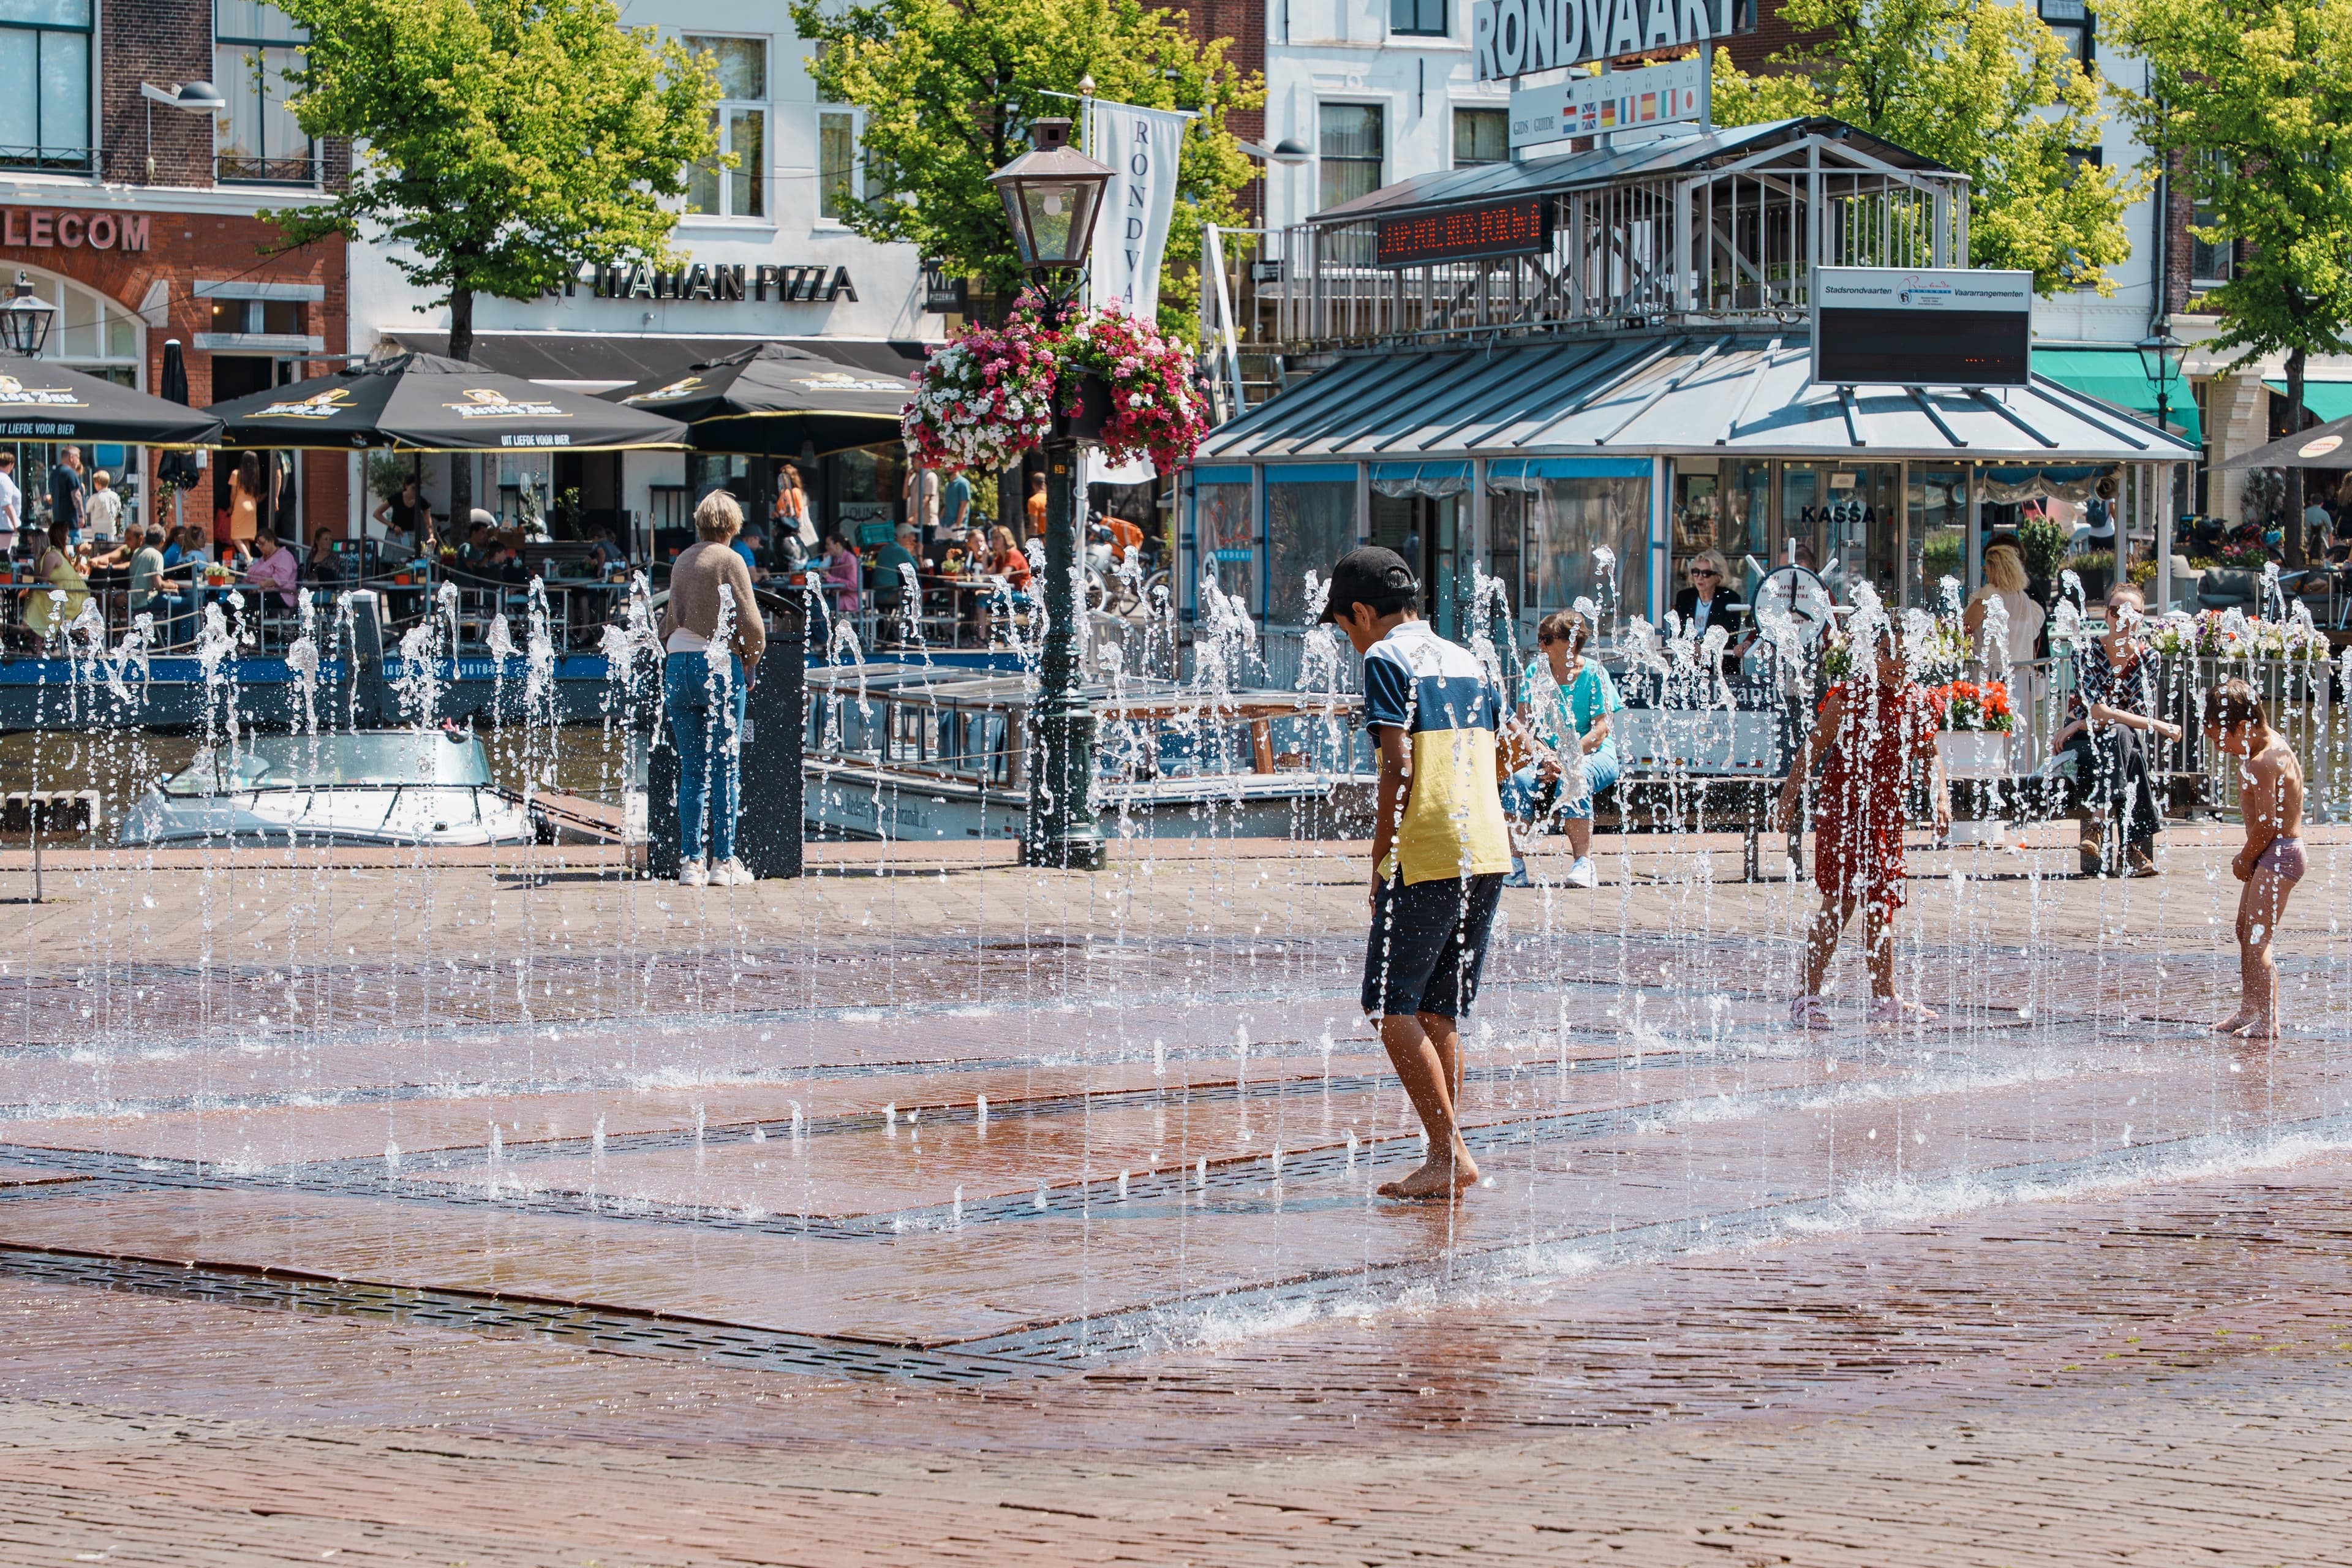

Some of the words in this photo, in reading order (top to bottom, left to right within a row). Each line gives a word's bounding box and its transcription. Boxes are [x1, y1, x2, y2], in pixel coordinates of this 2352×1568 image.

[1513, 120, 1529, 135] GIDS
[1534, 116, 1554, 132] GUIDE
[4, 209, 150, 250] LECOM
[594, 260, 745, 300] ITALIAN
[756, 265, 858, 302] PIZZA
[1825, 285, 1892, 294] Stadsrondvaarten
[1954, 288, 2024, 298] Vaararrangementen
[8, 423, 33, 434] LIEFDE
[36, 423, 55, 434] VOOR
[58, 424, 75, 435] BIER
[501, 434, 511, 446] UIT
[513, 434, 535, 446] LIEFDE
[536, 434, 553, 445] VOOR
[554, 434, 570, 445] BIER
[1801, 506, 1877, 522] KASSA
[1664, 680, 1777, 702] Rmbrand
